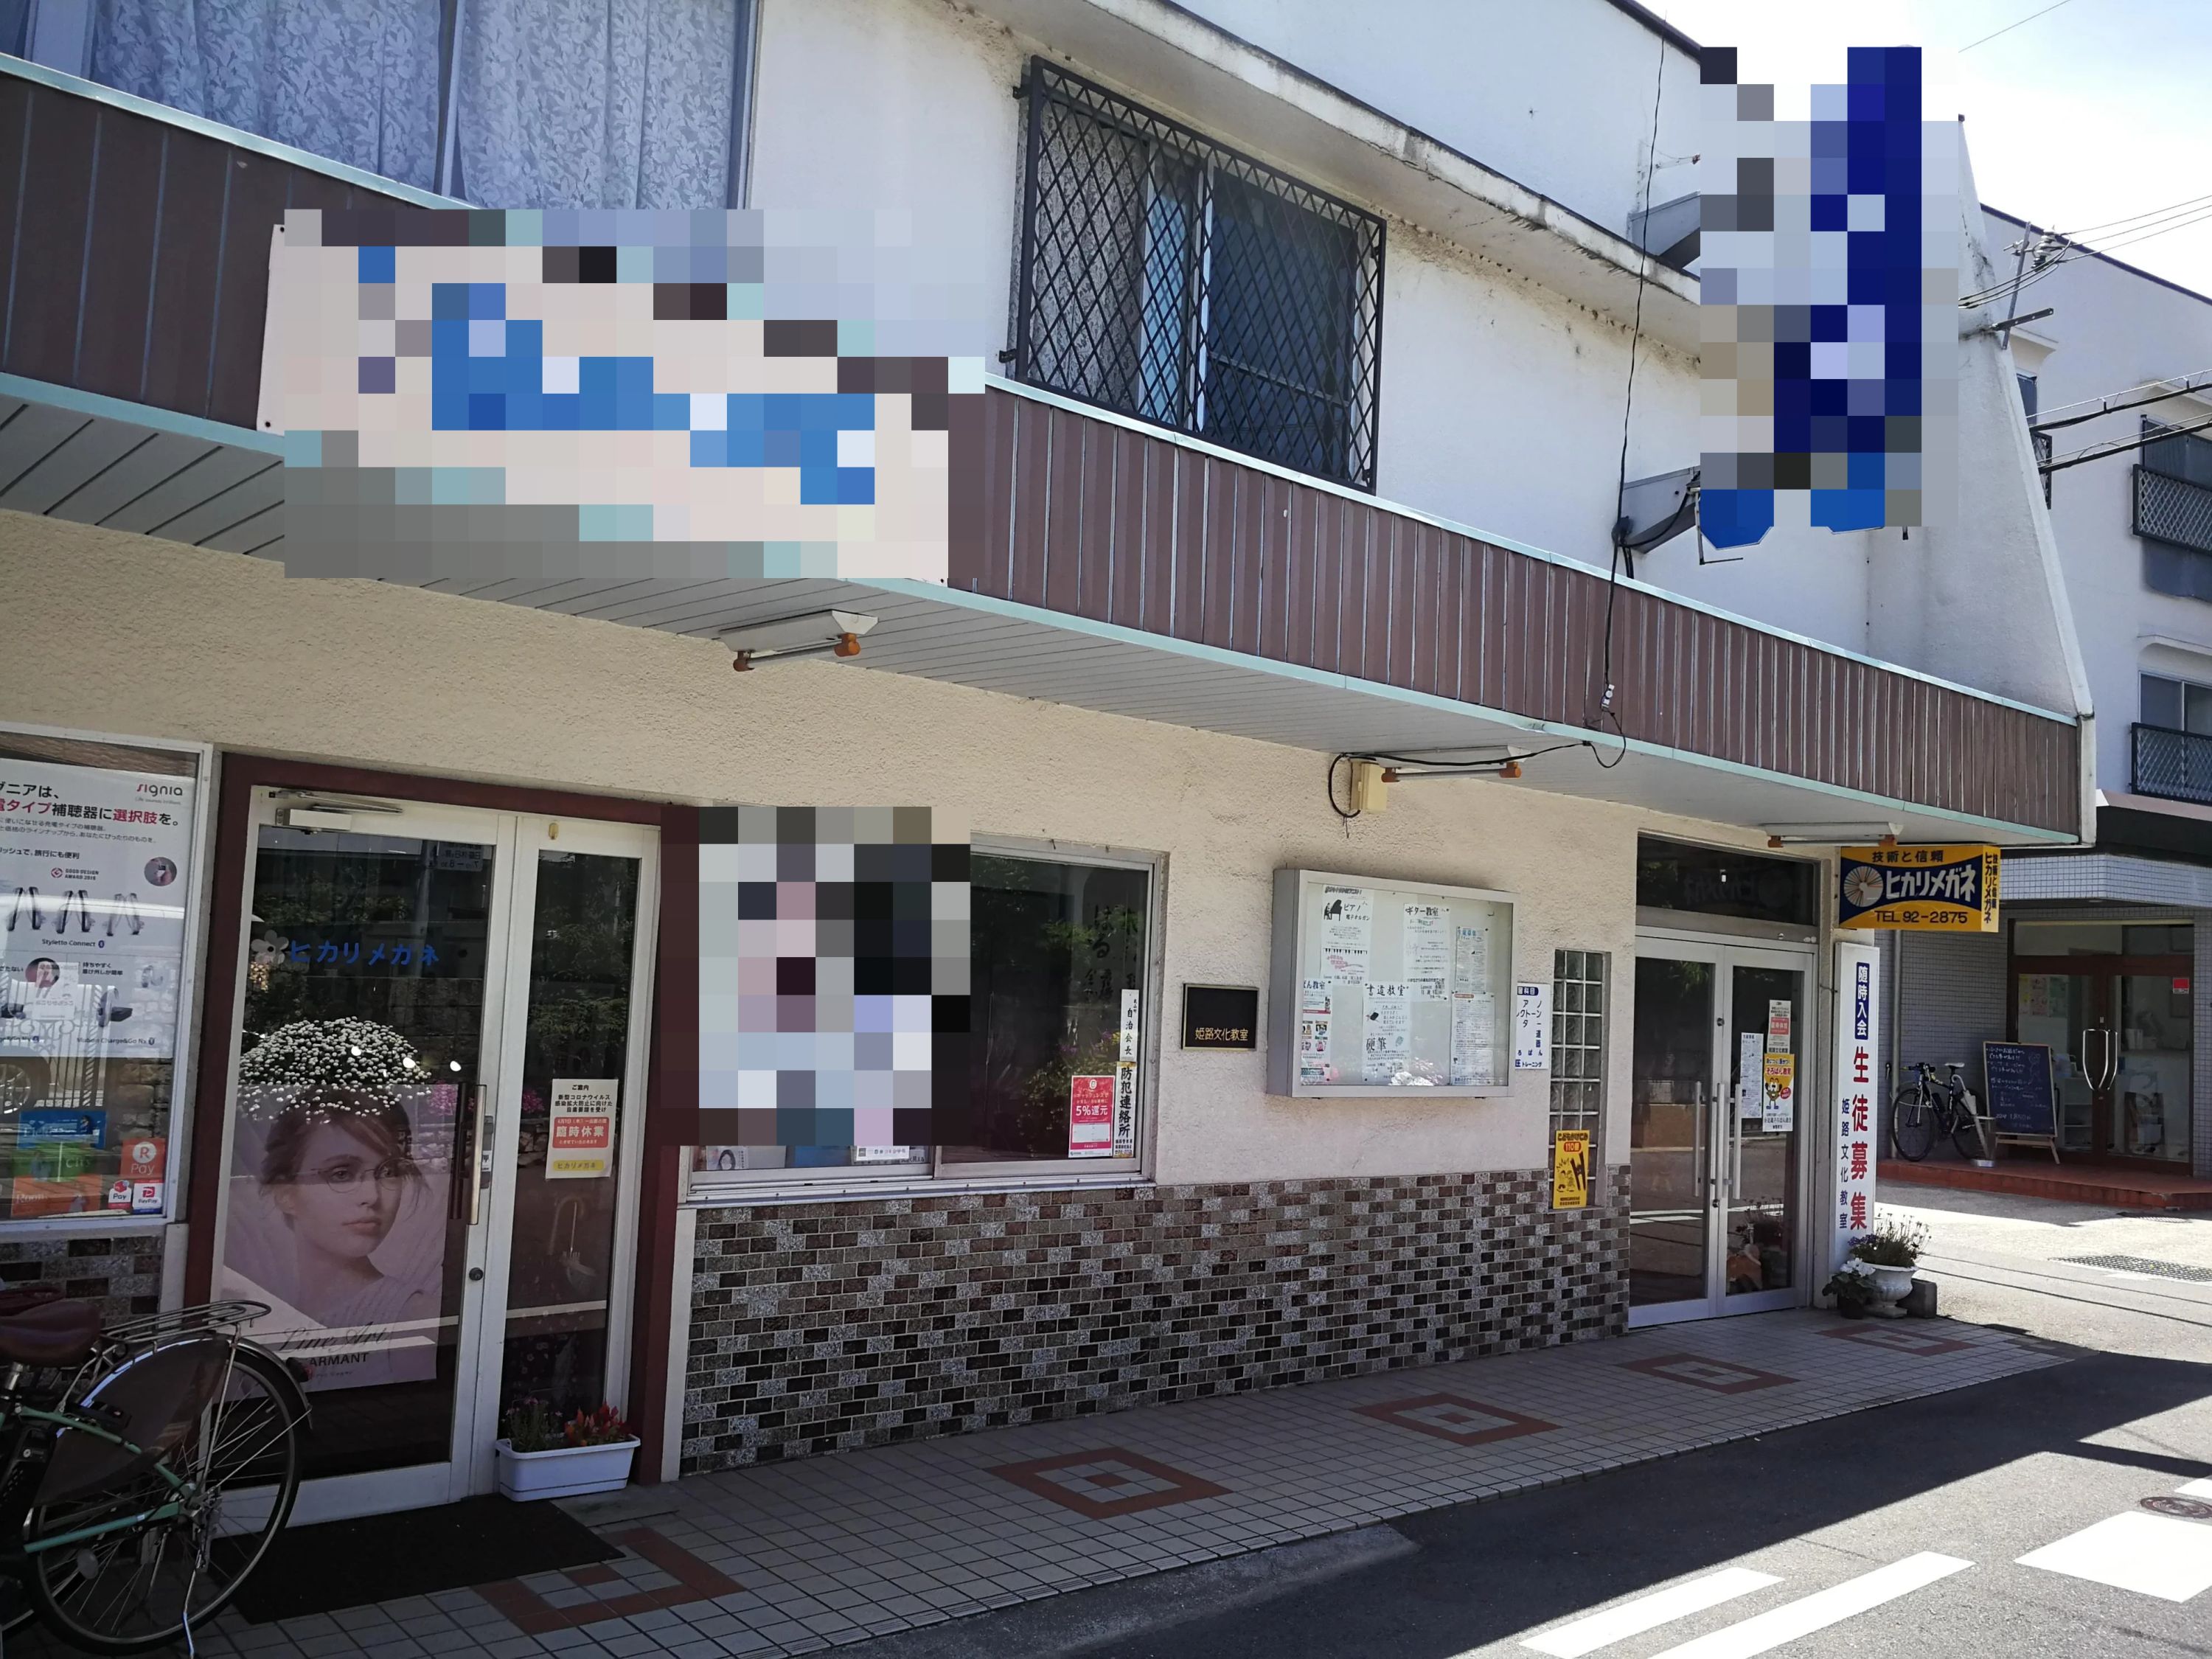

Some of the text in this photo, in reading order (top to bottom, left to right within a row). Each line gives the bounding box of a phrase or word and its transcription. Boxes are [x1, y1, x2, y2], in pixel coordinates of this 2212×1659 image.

[136, 784, 183, 797] signia
[0, 846, 80, 860] ッシュで、旅行にも便利
[1871, 850, 1944, 863] 技術と信頼
[1885, 864, 1976, 902] ヒカリメガネ
[1983, 852, 1993, 924] ヒカリメガネ
[1405, 906, 1439, 917] ギター教室
[1874, 911, 1968, 924] TEL 92-2875
[291, 939, 439, 966] ヒカリメガネ
[1366, 984, 1405, 996] 書道教室
[1124, 1007, 1133, 1056] 自治会長
[1194, 1027, 1248, 1041] 姫路文化教室
[1118, 1067, 1133, 1138] 防犯連絡所
[1076, 1105, 1108, 1116] 5%還元
[556, 1125, 605, 1138] 臨時休業
[1850, 1046, 1869, 1230] 生徒募集
[131, 1163, 155, 1175] Pay
[1839, 1098, 1850, 1229] 姫路文化教室
[310, 1353, 369, 1366] ARMANT
